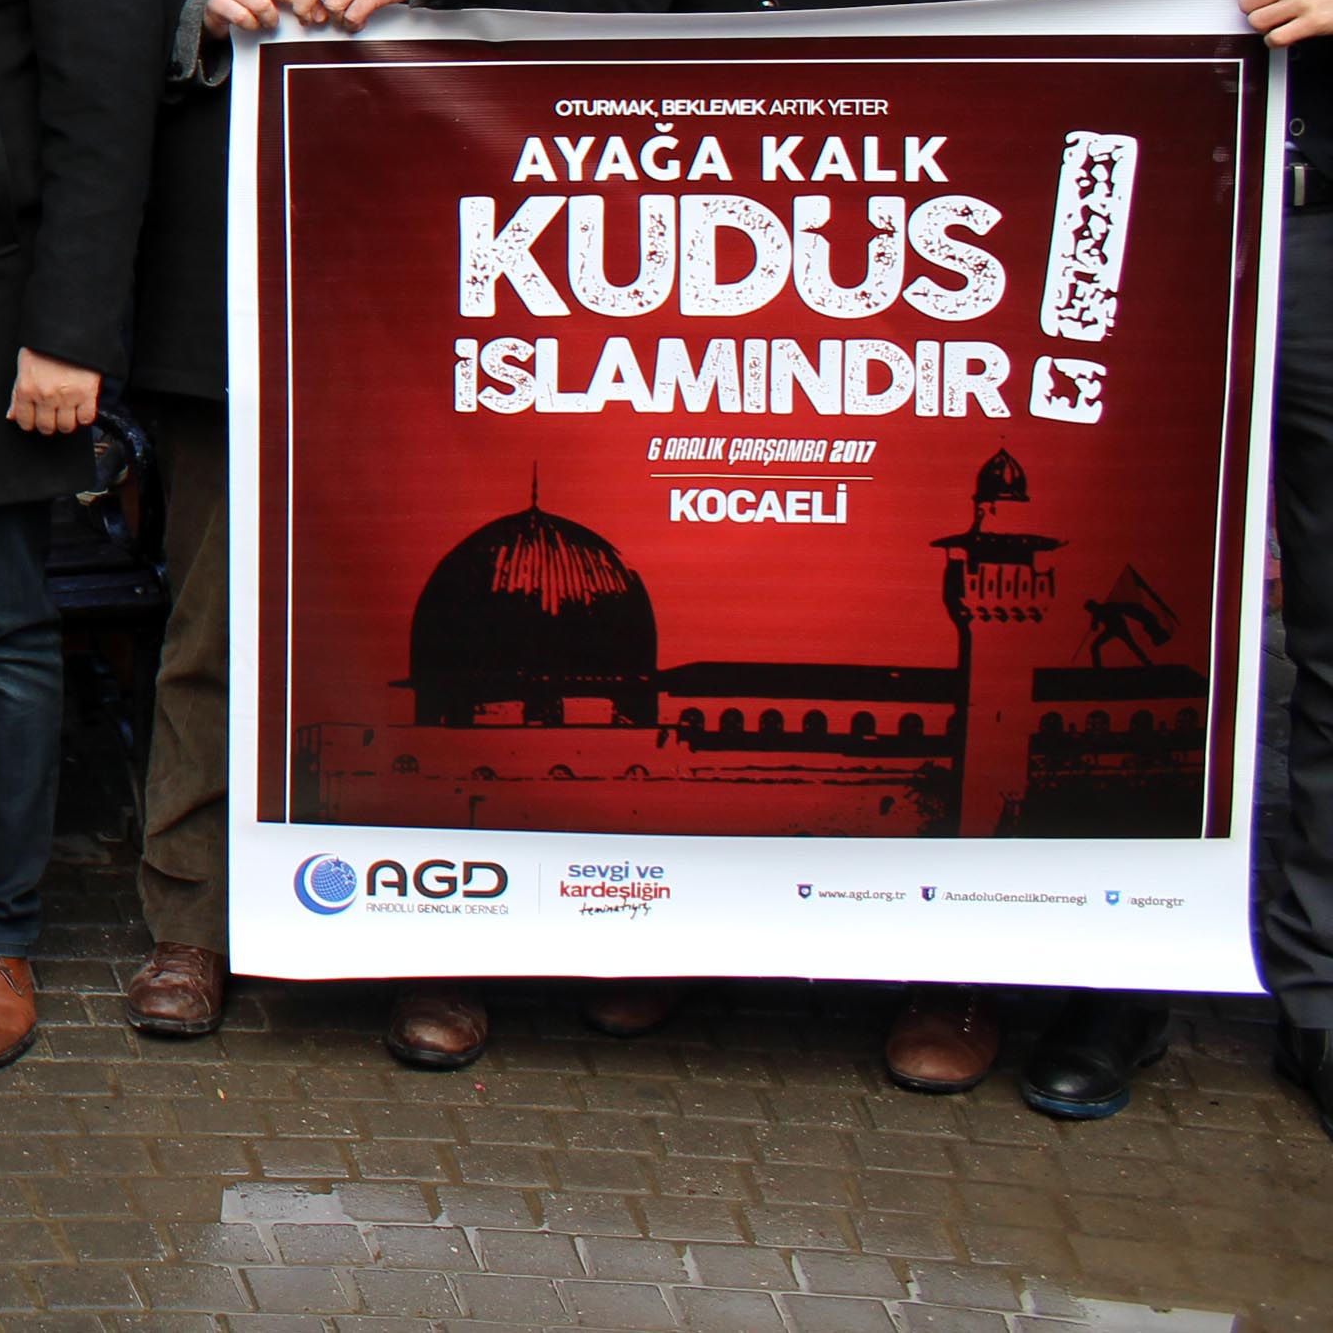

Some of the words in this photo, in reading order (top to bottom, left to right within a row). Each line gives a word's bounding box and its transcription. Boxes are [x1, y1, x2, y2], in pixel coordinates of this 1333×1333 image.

[554, 99, 659, 117] OTURMAK,
[661, 99, 766, 116] BEKLEMEK
[768, 99, 825, 115] ARTIK
[827, 99, 889, 115] YETER
[511, 122, 733, 182] AYAĞA
[761, 135, 951, 182] KALK
[646, 438, 663, 460] 6
[663, 438, 727, 461] ARALIK
[728, 438, 828, 466] ÇARŞAMBA
[828, 440, 877, 463] 2017
[669, 483, 848, 524] KOCAELİ
[365, 858, 509, 897] AGD
[567, 861, 630, 880] sevgi
[636, 864, 664, 879] ve
[559, 879, 671, 902] kardeşliğin
[817, 889, 907, 901] www.agd.org.tr
[365, 902, 414, 914] ANADOLU
